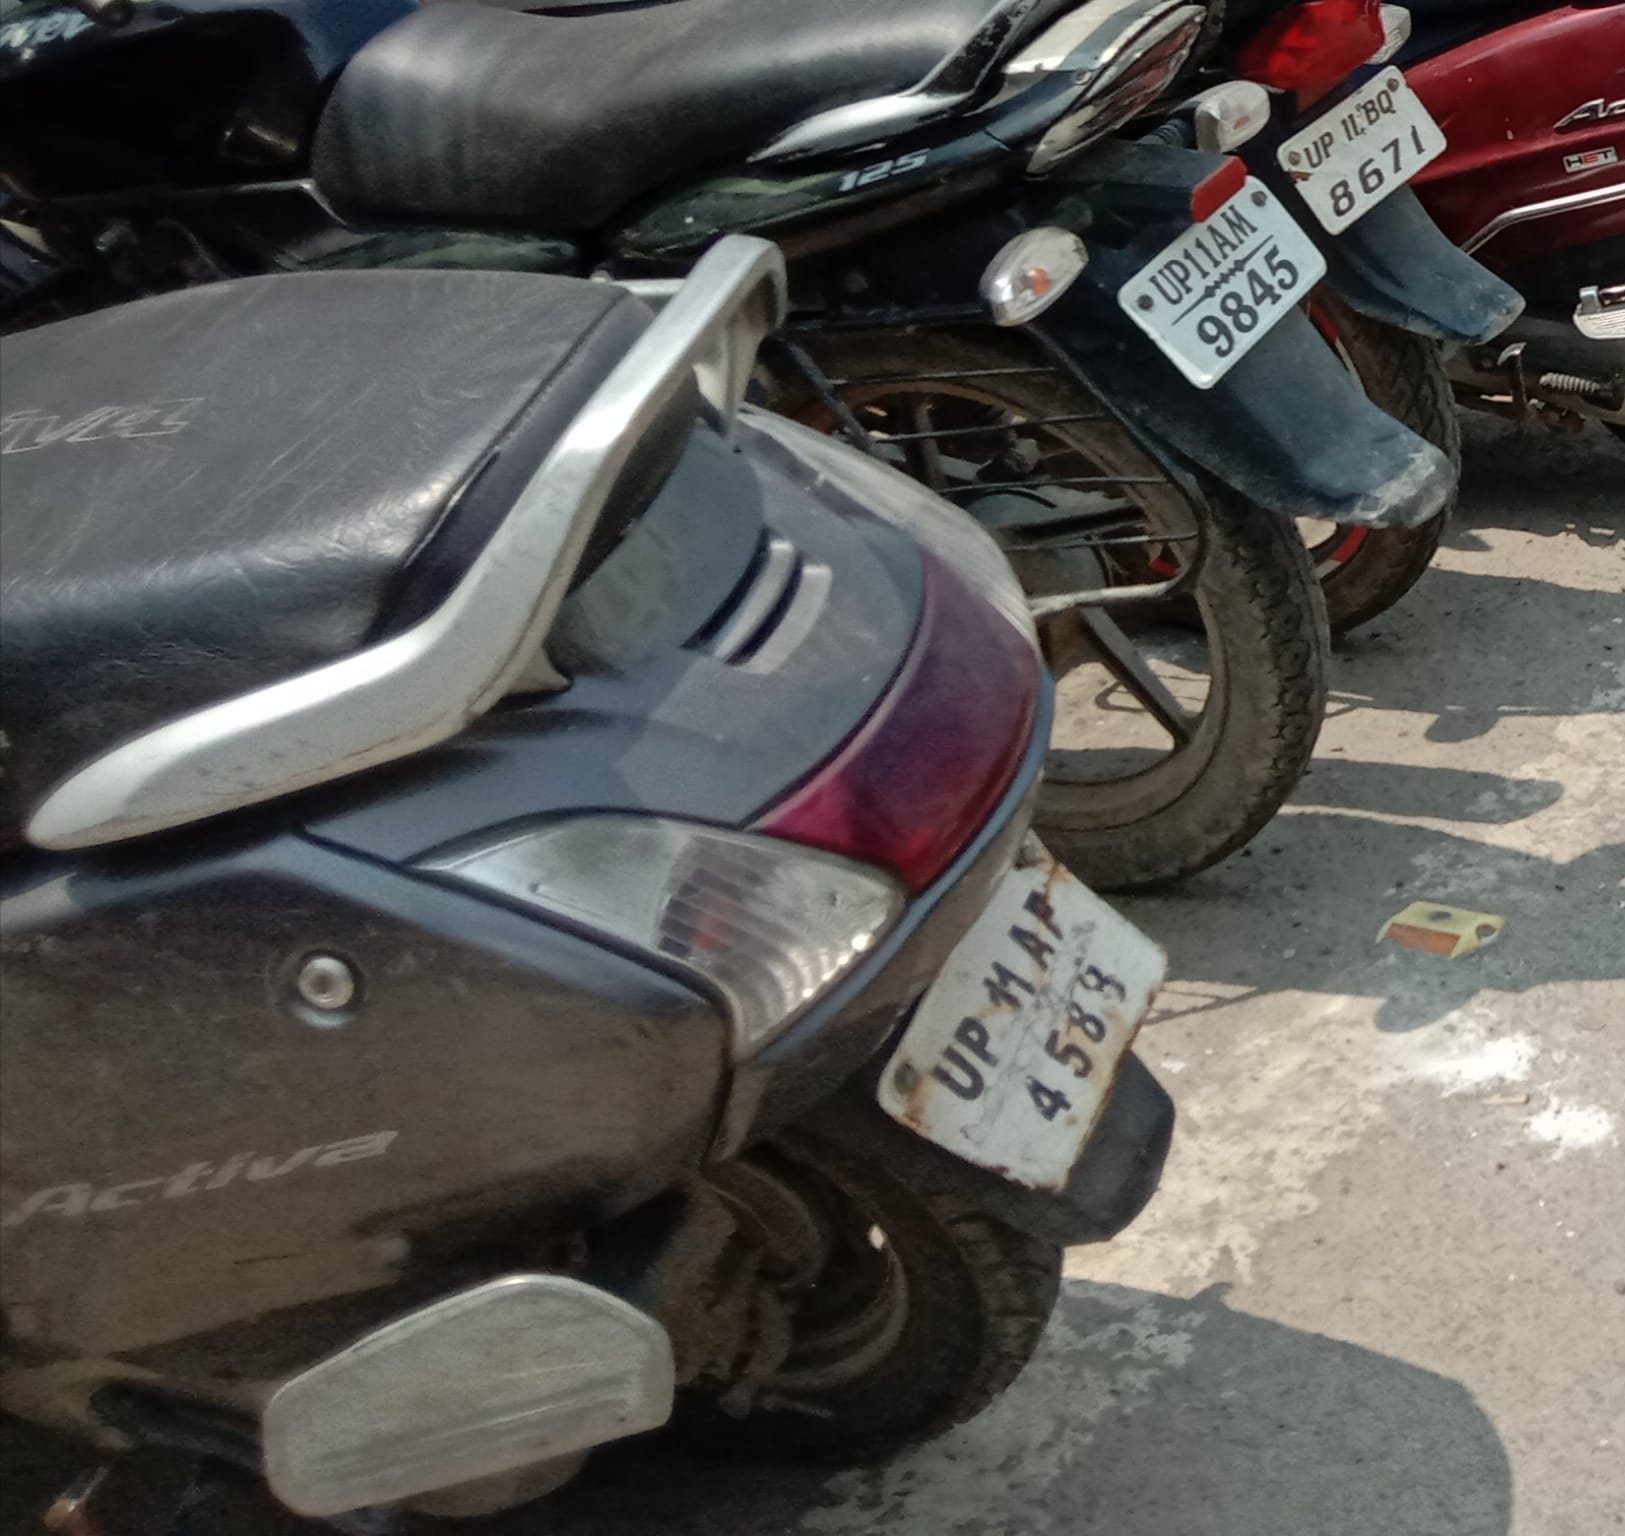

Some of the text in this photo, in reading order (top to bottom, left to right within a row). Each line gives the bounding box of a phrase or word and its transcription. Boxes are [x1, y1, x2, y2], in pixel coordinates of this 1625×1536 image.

[838, 147, 931, 193] 125
[1303, 131, 1335, 169] UP
[1329, 124, 1427, 218] 8671
[1566, 148, 1615, 171] HET
[1150, 204, 1259, 308] UP11AM
[1197, 245, 1300, 358] 9845
[930, 1016, 998, 1102] UP
[2, 1130, 399, 1227] Activa
